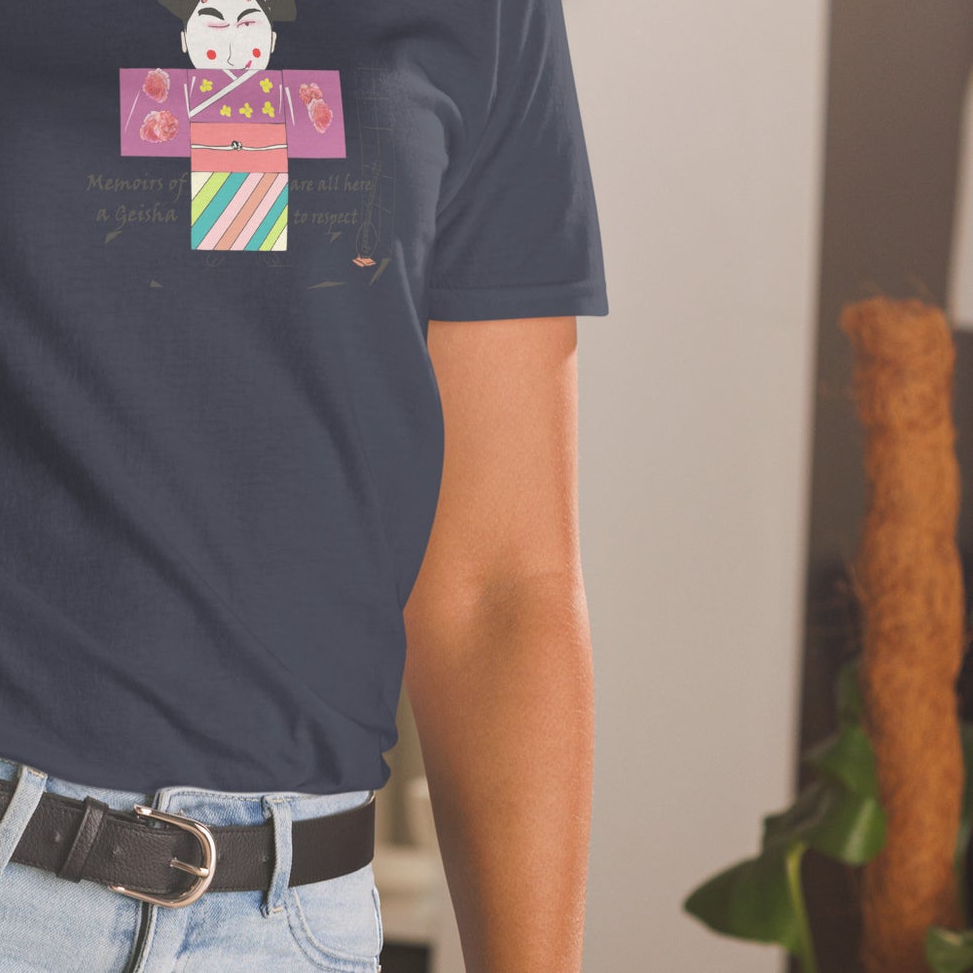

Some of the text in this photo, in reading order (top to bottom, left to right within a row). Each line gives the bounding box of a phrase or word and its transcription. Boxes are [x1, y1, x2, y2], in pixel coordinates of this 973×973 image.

[86, 171, 190, 203] Memoirs of
[290, 173, 372, 192] are all here
[95, 203, 179, 230] a Geisha
[292, 209, 360, 235] to respect
